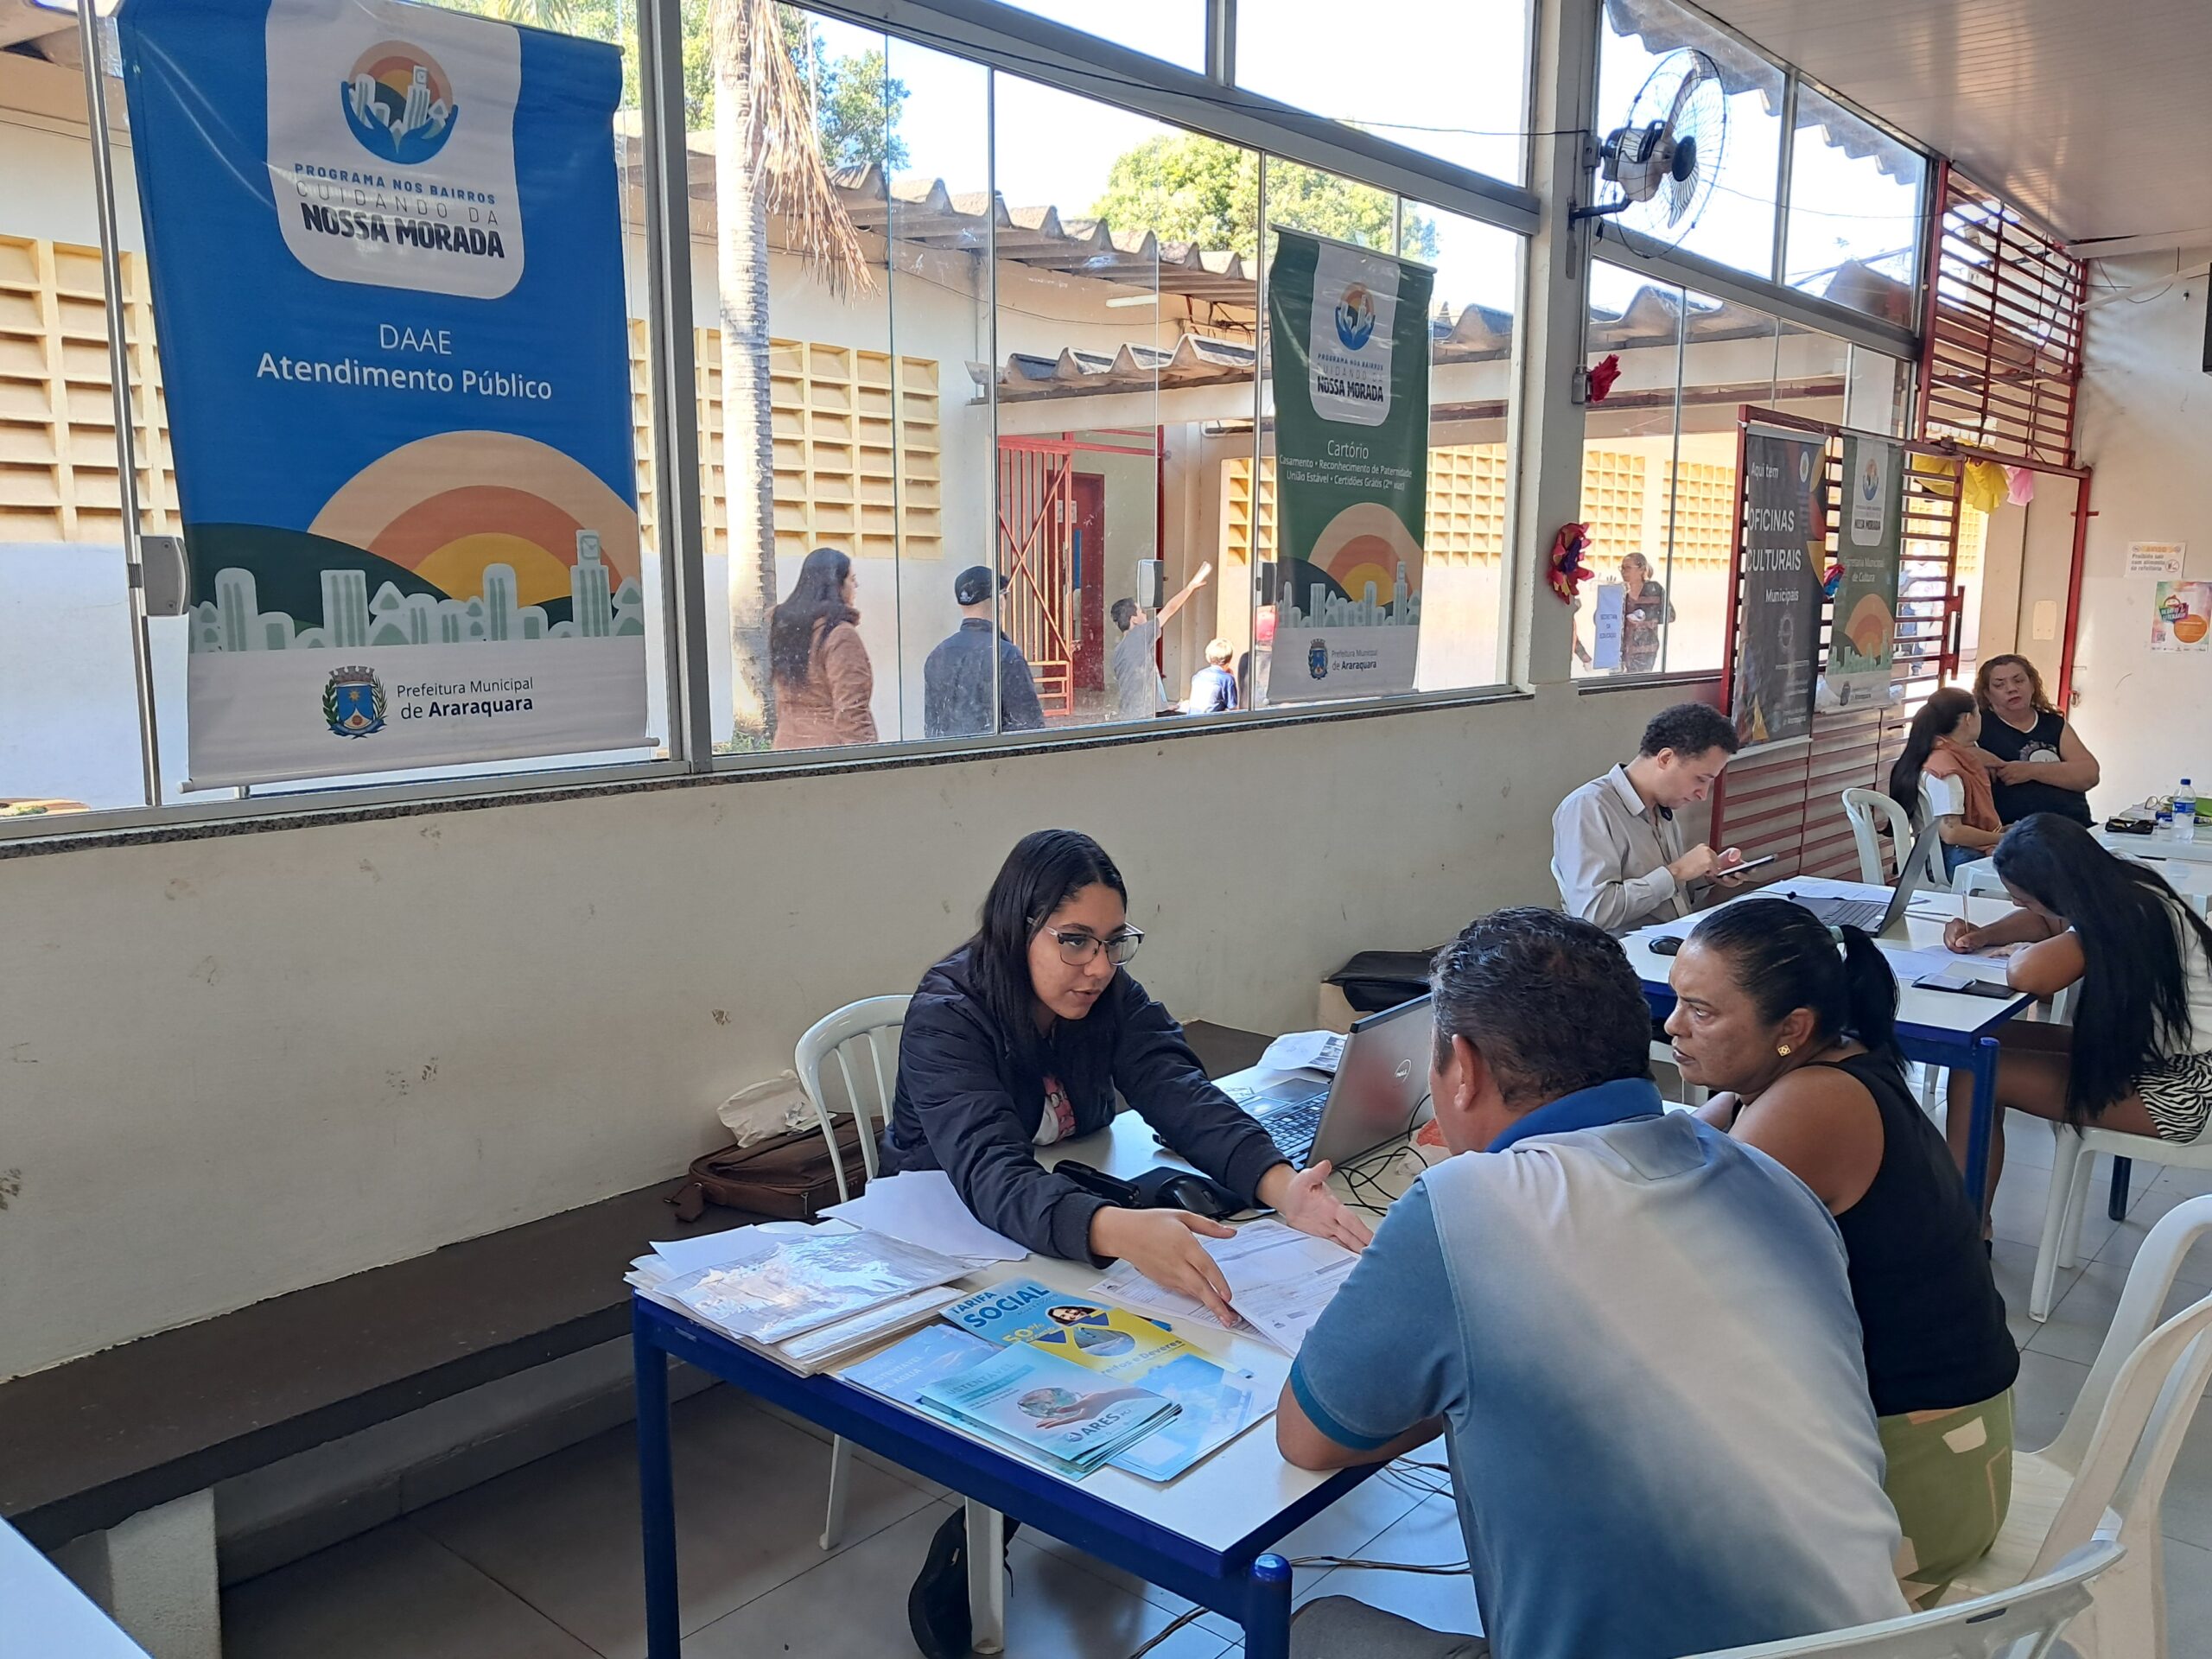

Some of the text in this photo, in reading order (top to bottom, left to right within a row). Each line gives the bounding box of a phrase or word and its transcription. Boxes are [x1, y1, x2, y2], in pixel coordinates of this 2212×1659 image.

[295, 163, 496, 205] PROGRAMA NOS BAIRROS
[296, 180, 499, 226] CUIDANDO DA
[301, 202, 505, 258] NOSSA MORADA
[379, 323, 453, 355] DAAE
[1318, 353, 1348, 364] PROGRAMA
[257, 352, 553, 400] Atendimento Público
[1318, 375, 1384, 403] NOSSA MORADA
[1327, 439, 1369, 460] Cartório
[1279, 454, 1413, 478] Casamento Reconhecimento de Paternidade
[1751, 461, 1779, 480] Aqui tem
[1287, 470, 1306, 481] União
[1306, 472, 1329, 483] Estável
[1333, 475, 1363, 486] Certidões
[1364, 477, 1382, 488] Grátis
[1748, 508, 1795, 532] OFICINAS
[1746, 548, 1802, 572] CULTURAIS
[1765, 588, 1799, 606] Municipais
[1332, 660, 1376, 672] de Araraquara
[397, 677, 534, 698] Prefeitura Municipal
[400, 696, 533, 720] de Araraquara
[950, 1291, 998, 1315] TARIFA
[963, 1285, 1051, 1329] SOCIAL
[1140, 1339, 1183, 1360] Deveres
[1081, 1414, 1121, 1436] ARES
